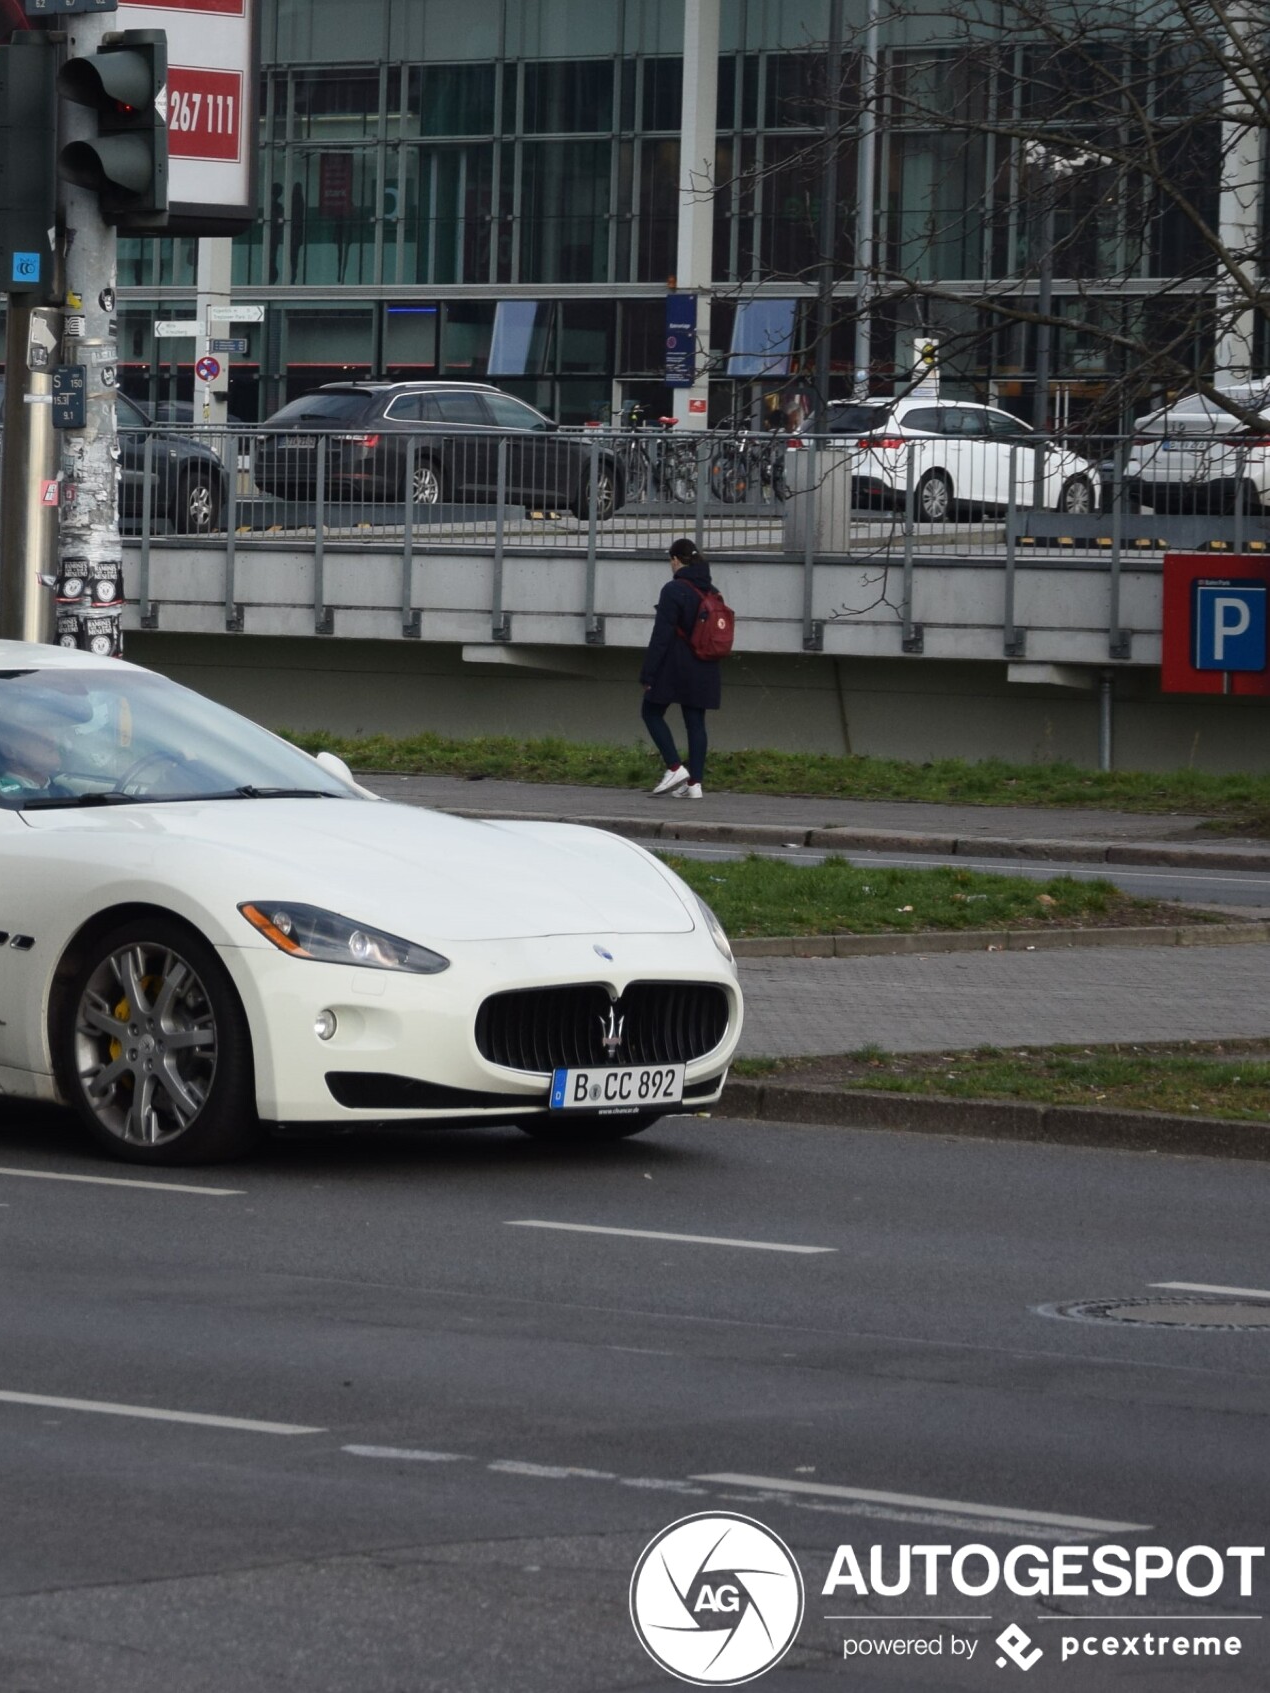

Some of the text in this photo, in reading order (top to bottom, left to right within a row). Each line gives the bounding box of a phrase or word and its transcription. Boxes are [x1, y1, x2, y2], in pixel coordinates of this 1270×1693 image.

[169, 90, 234, 135] 267 111
[53, 375, 62, 388] S
[1214, 597, 1251, 661] P
[573, 1073, 589, 1102] B
[604, 1072, 632, 1101] CC
[638, 1068, 676, 1099] 892
